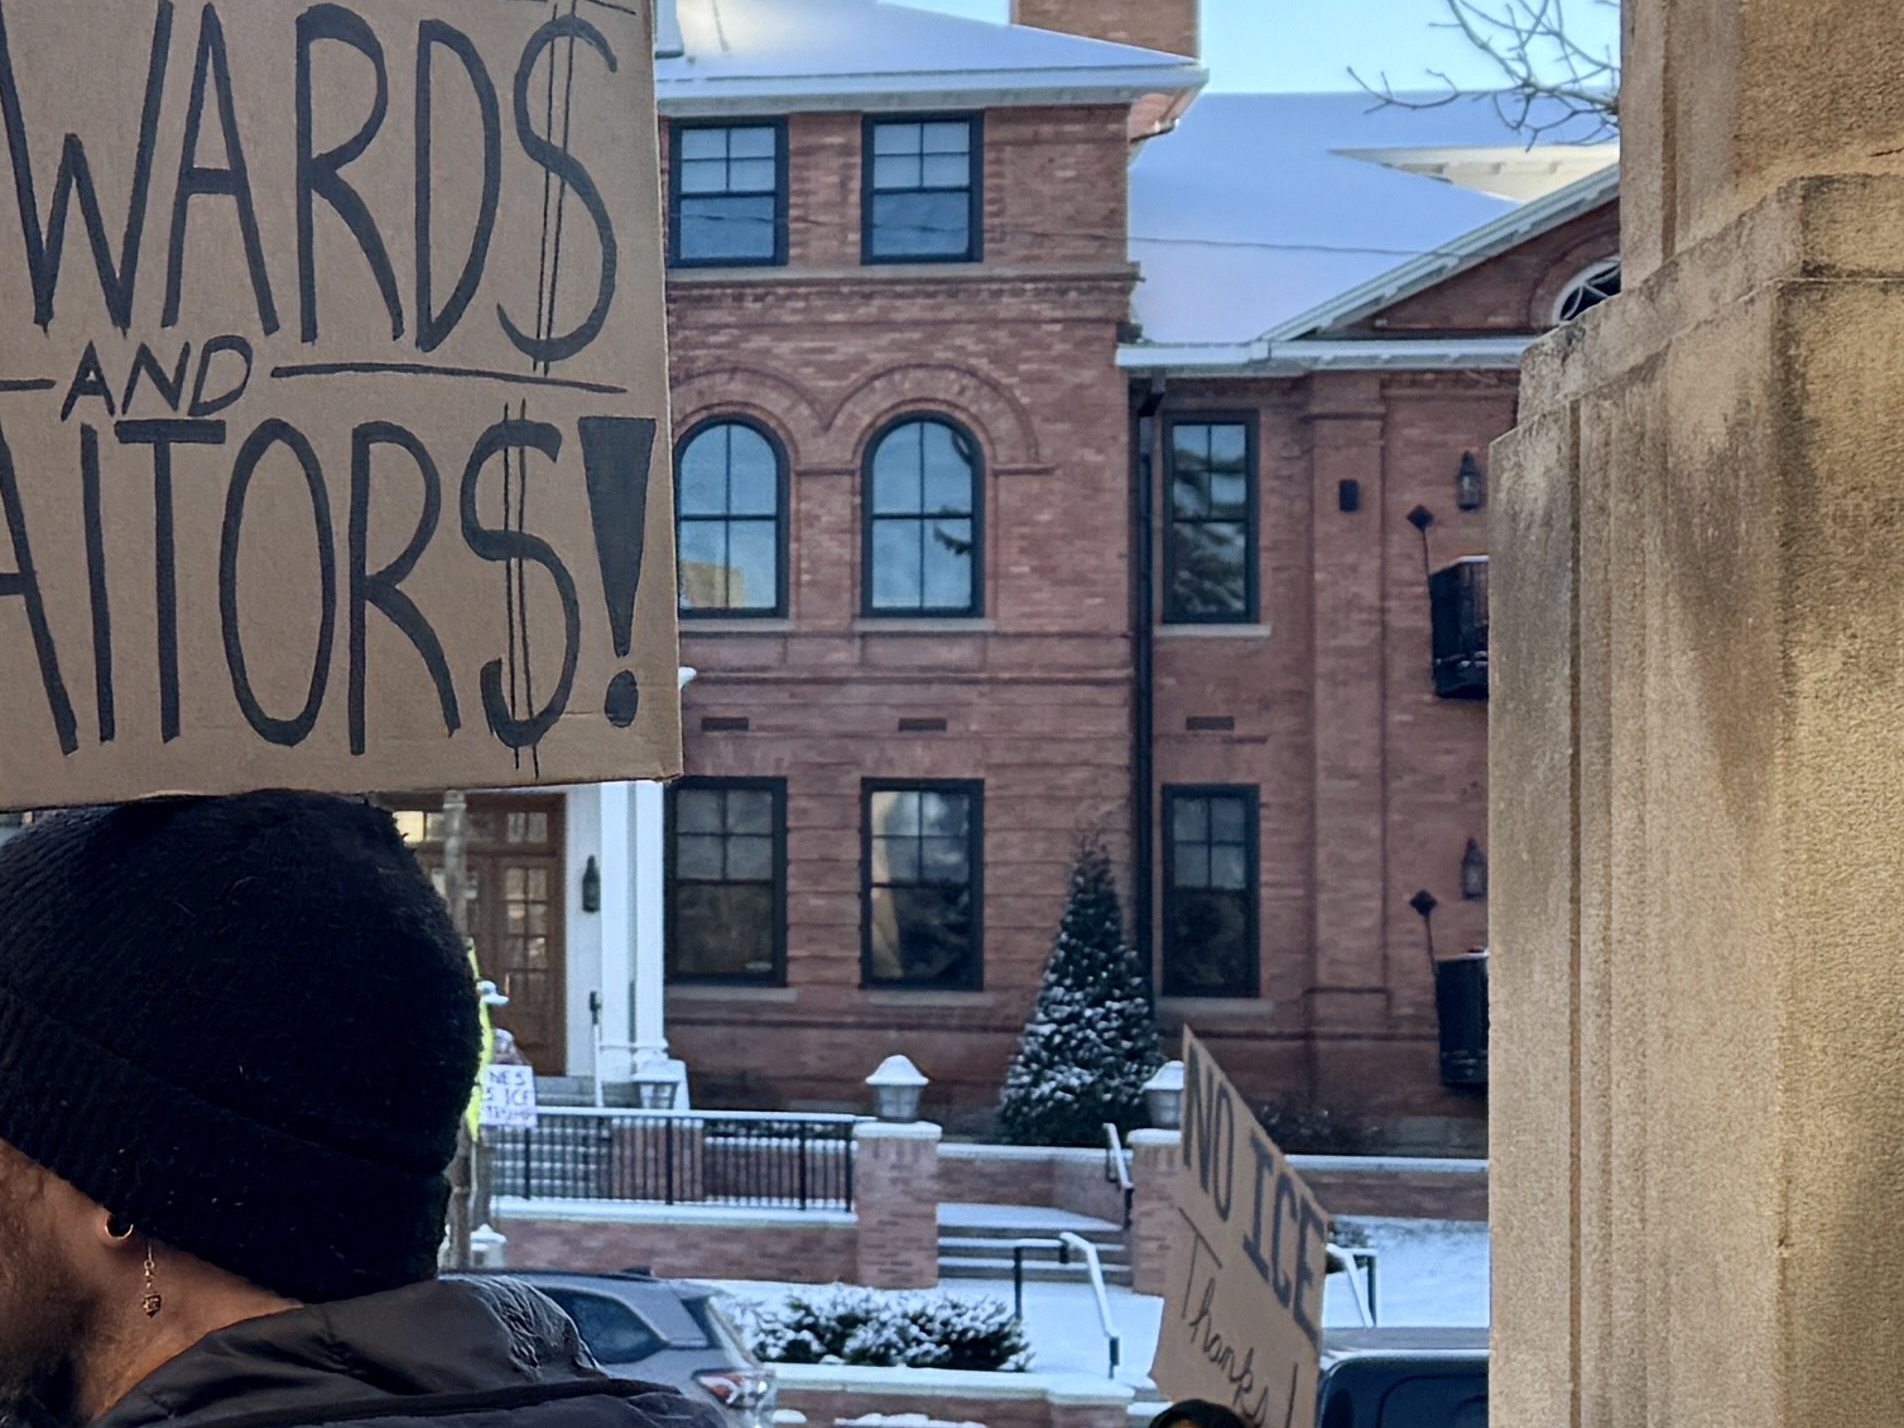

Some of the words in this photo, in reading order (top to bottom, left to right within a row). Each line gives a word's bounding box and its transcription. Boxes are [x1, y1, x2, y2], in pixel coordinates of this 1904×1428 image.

[59, 335, 253, 423] AND
[1182, 1044, 1234, 1223] NO
[1242, 1128, 1325, 1352] ICE
